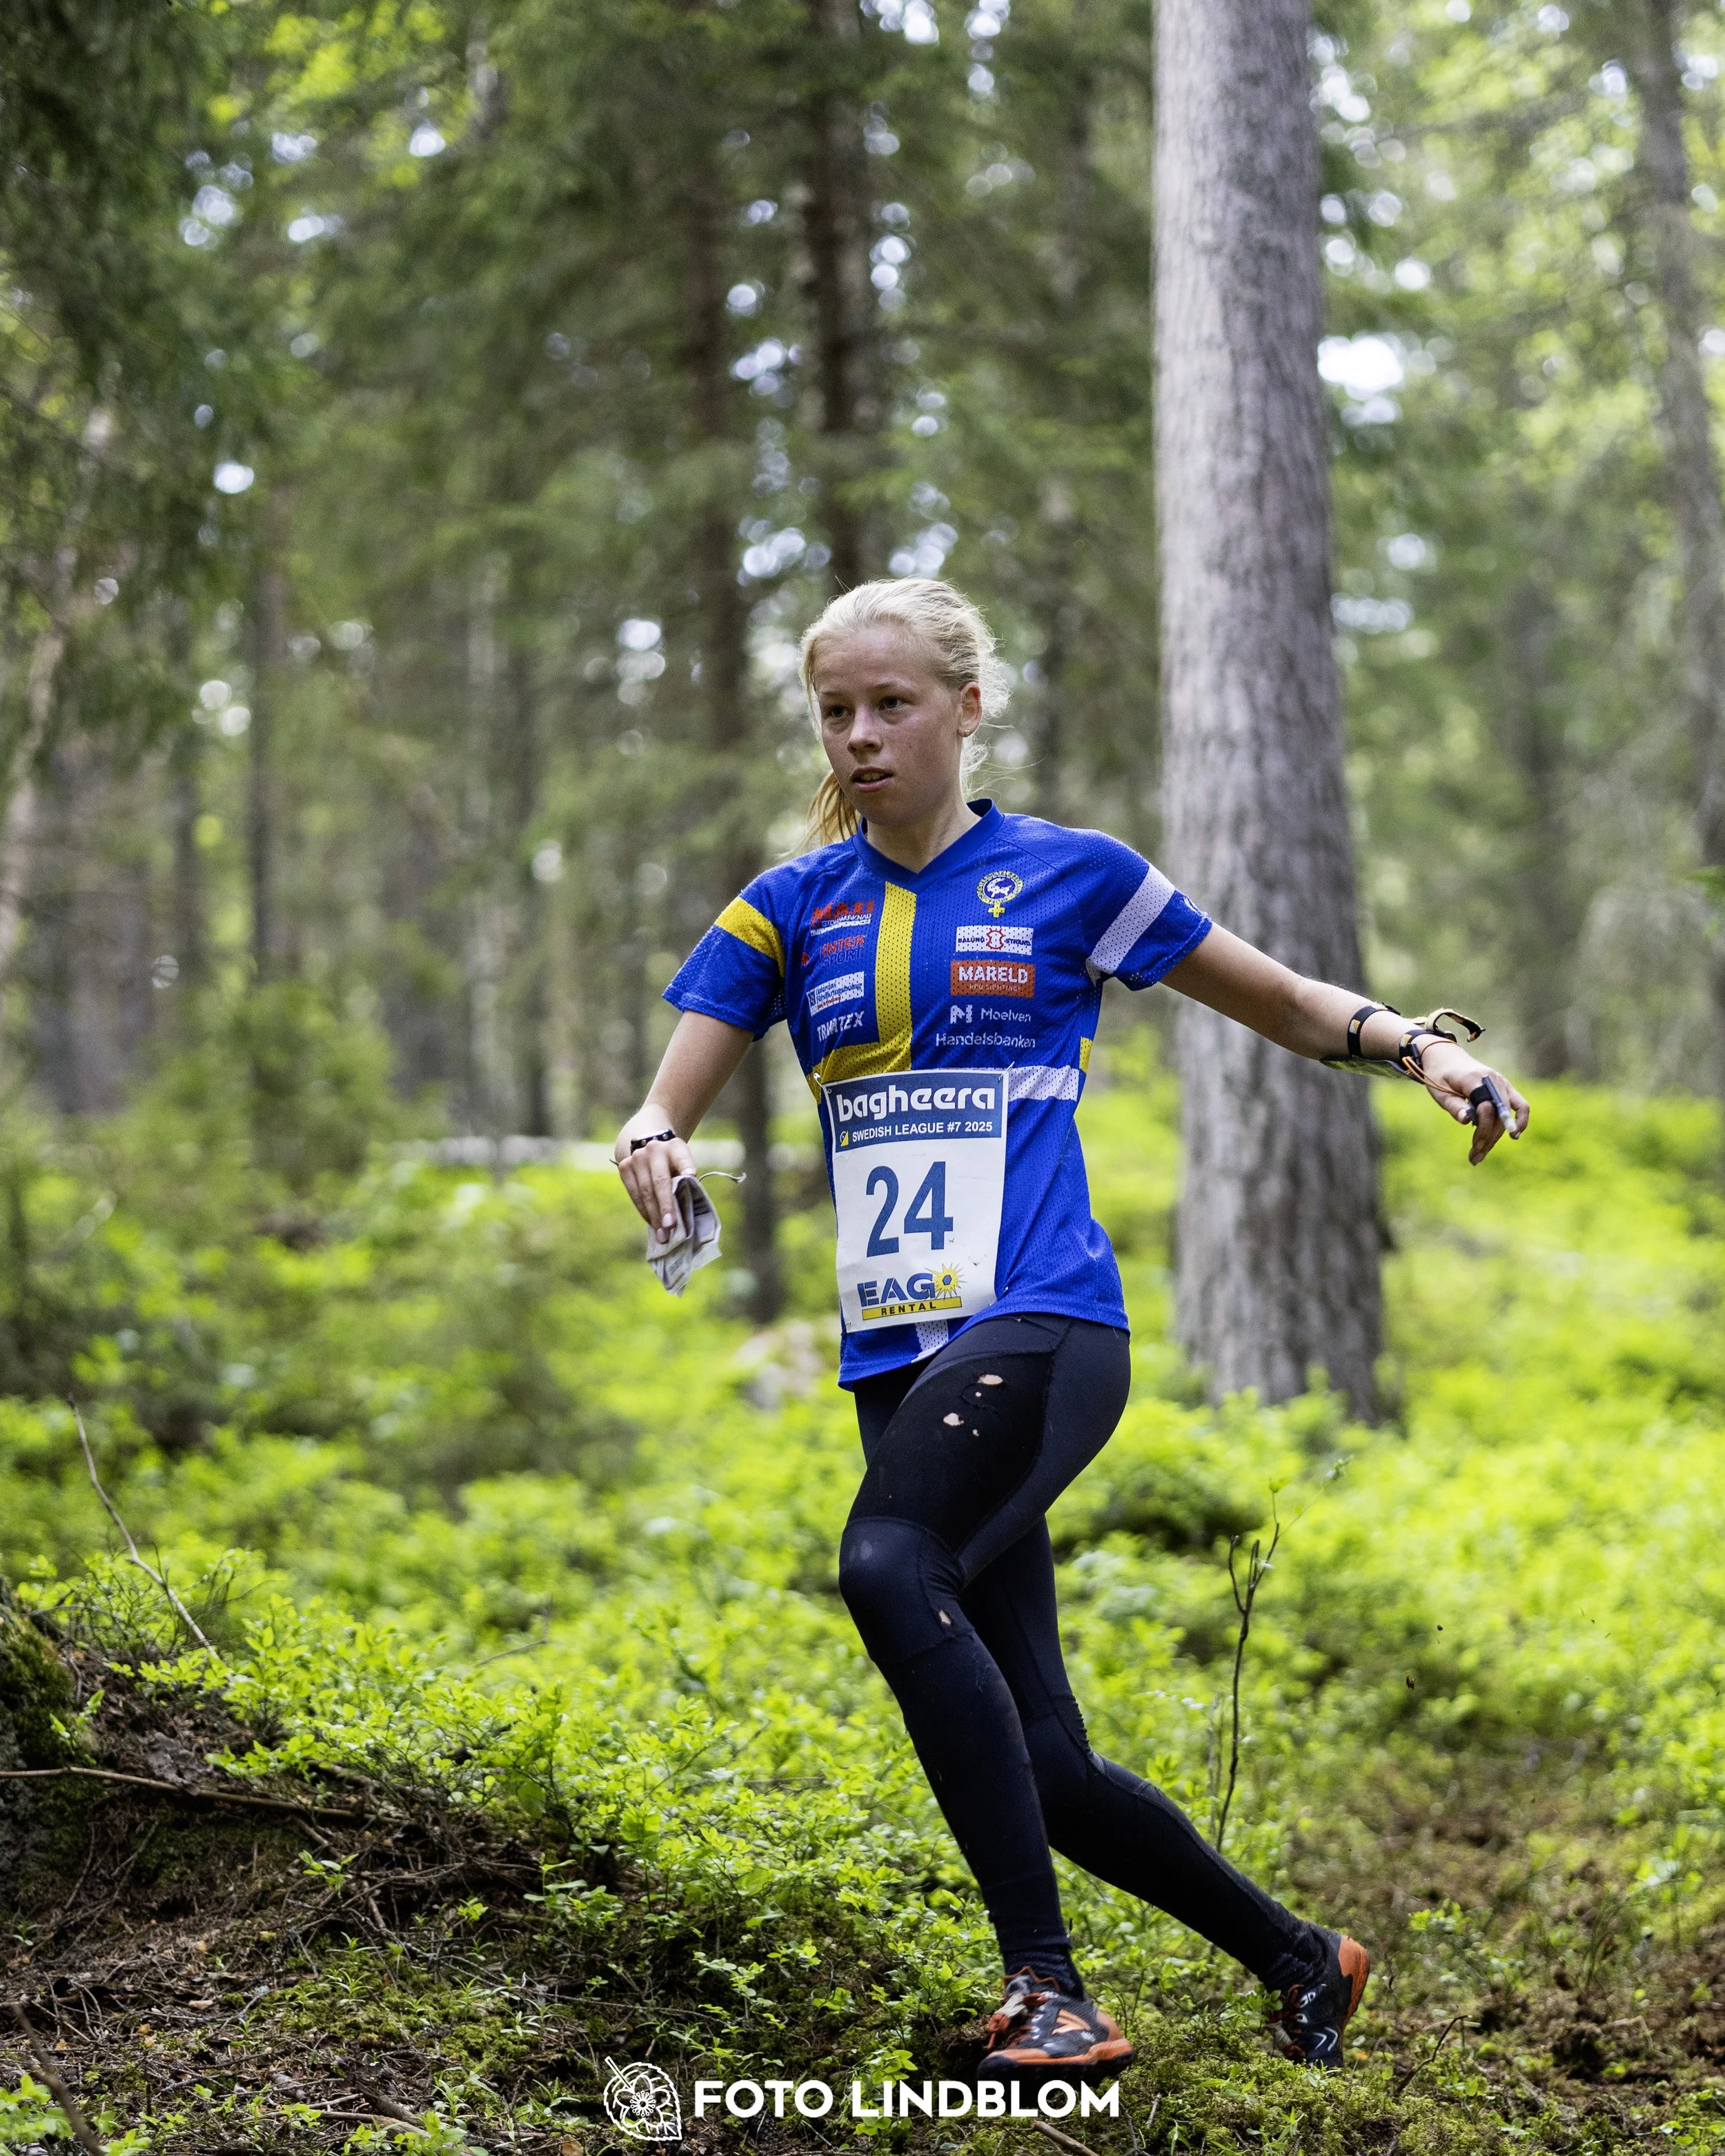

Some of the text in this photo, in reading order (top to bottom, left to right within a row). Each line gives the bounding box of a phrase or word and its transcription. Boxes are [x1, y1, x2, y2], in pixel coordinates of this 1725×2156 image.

[811, 900, 874, 923] MAXI
[822, 935, 866, 957] INTER
[822, 947, 863, 967] SPORT
[958, 965, 1028, 984] MARELD
[981, 1007, 1032, 1022] Moelven
[936, 1033, 1035, 1048] Handelsbanken
[836, 1084, 996, 1122] bagheera
[852, 1121, 993, 1143] SWEDISH LEAGUE #7 2025
[865, 1161, 954, 1258] 24
[881, 1301, 937, 1316] RENTAL
